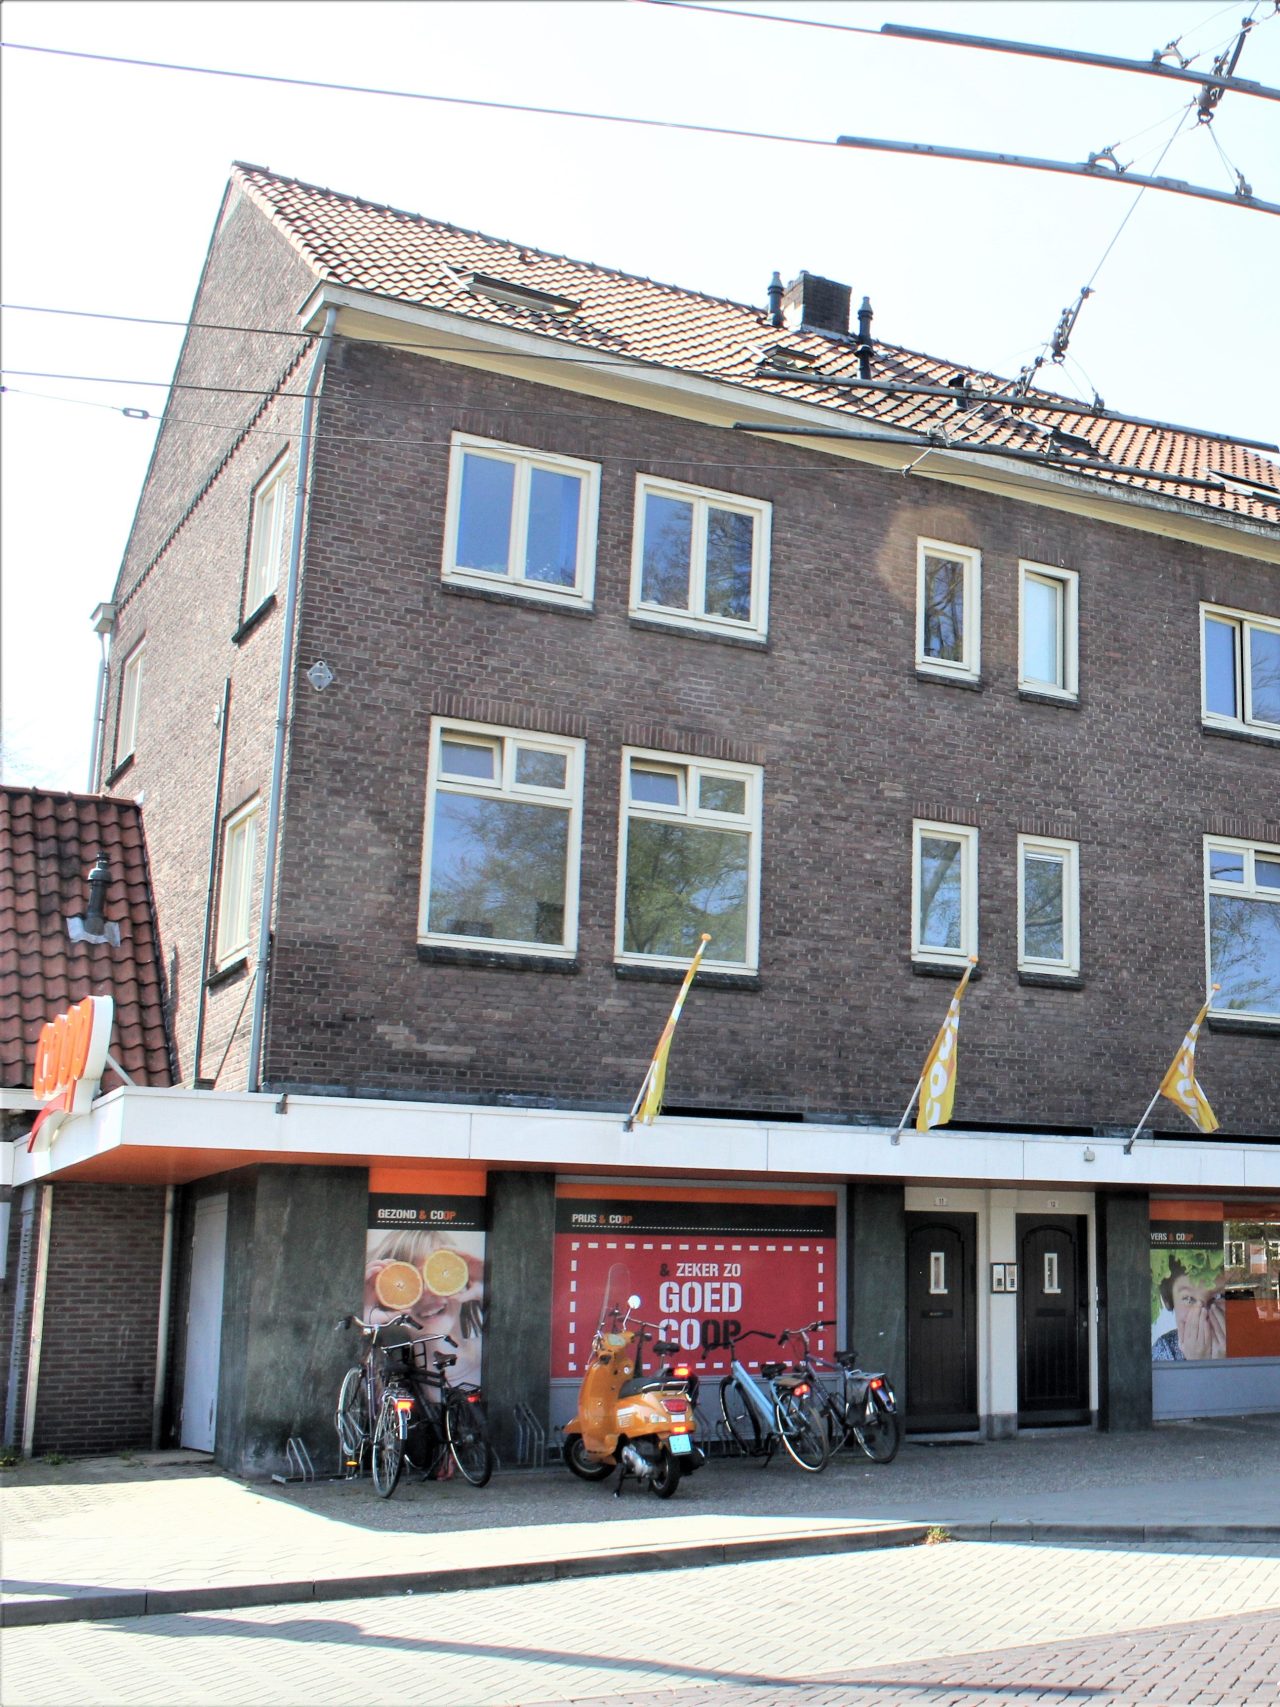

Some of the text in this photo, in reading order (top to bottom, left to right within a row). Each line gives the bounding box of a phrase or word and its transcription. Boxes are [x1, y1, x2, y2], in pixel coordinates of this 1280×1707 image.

[377, 1208, 456, 1220] GEZOND & COOP
[599, 1215, 605, 1224] &
[609, 1215, 633, 1224] COOP
[1150, 1232, 1168, 1241] VERS
[660, 1263, 741, 1277] & ZEKER ZO
[659, 1281, 742, 1313] GOED
[658, 1318, 742, 1351] COOP
